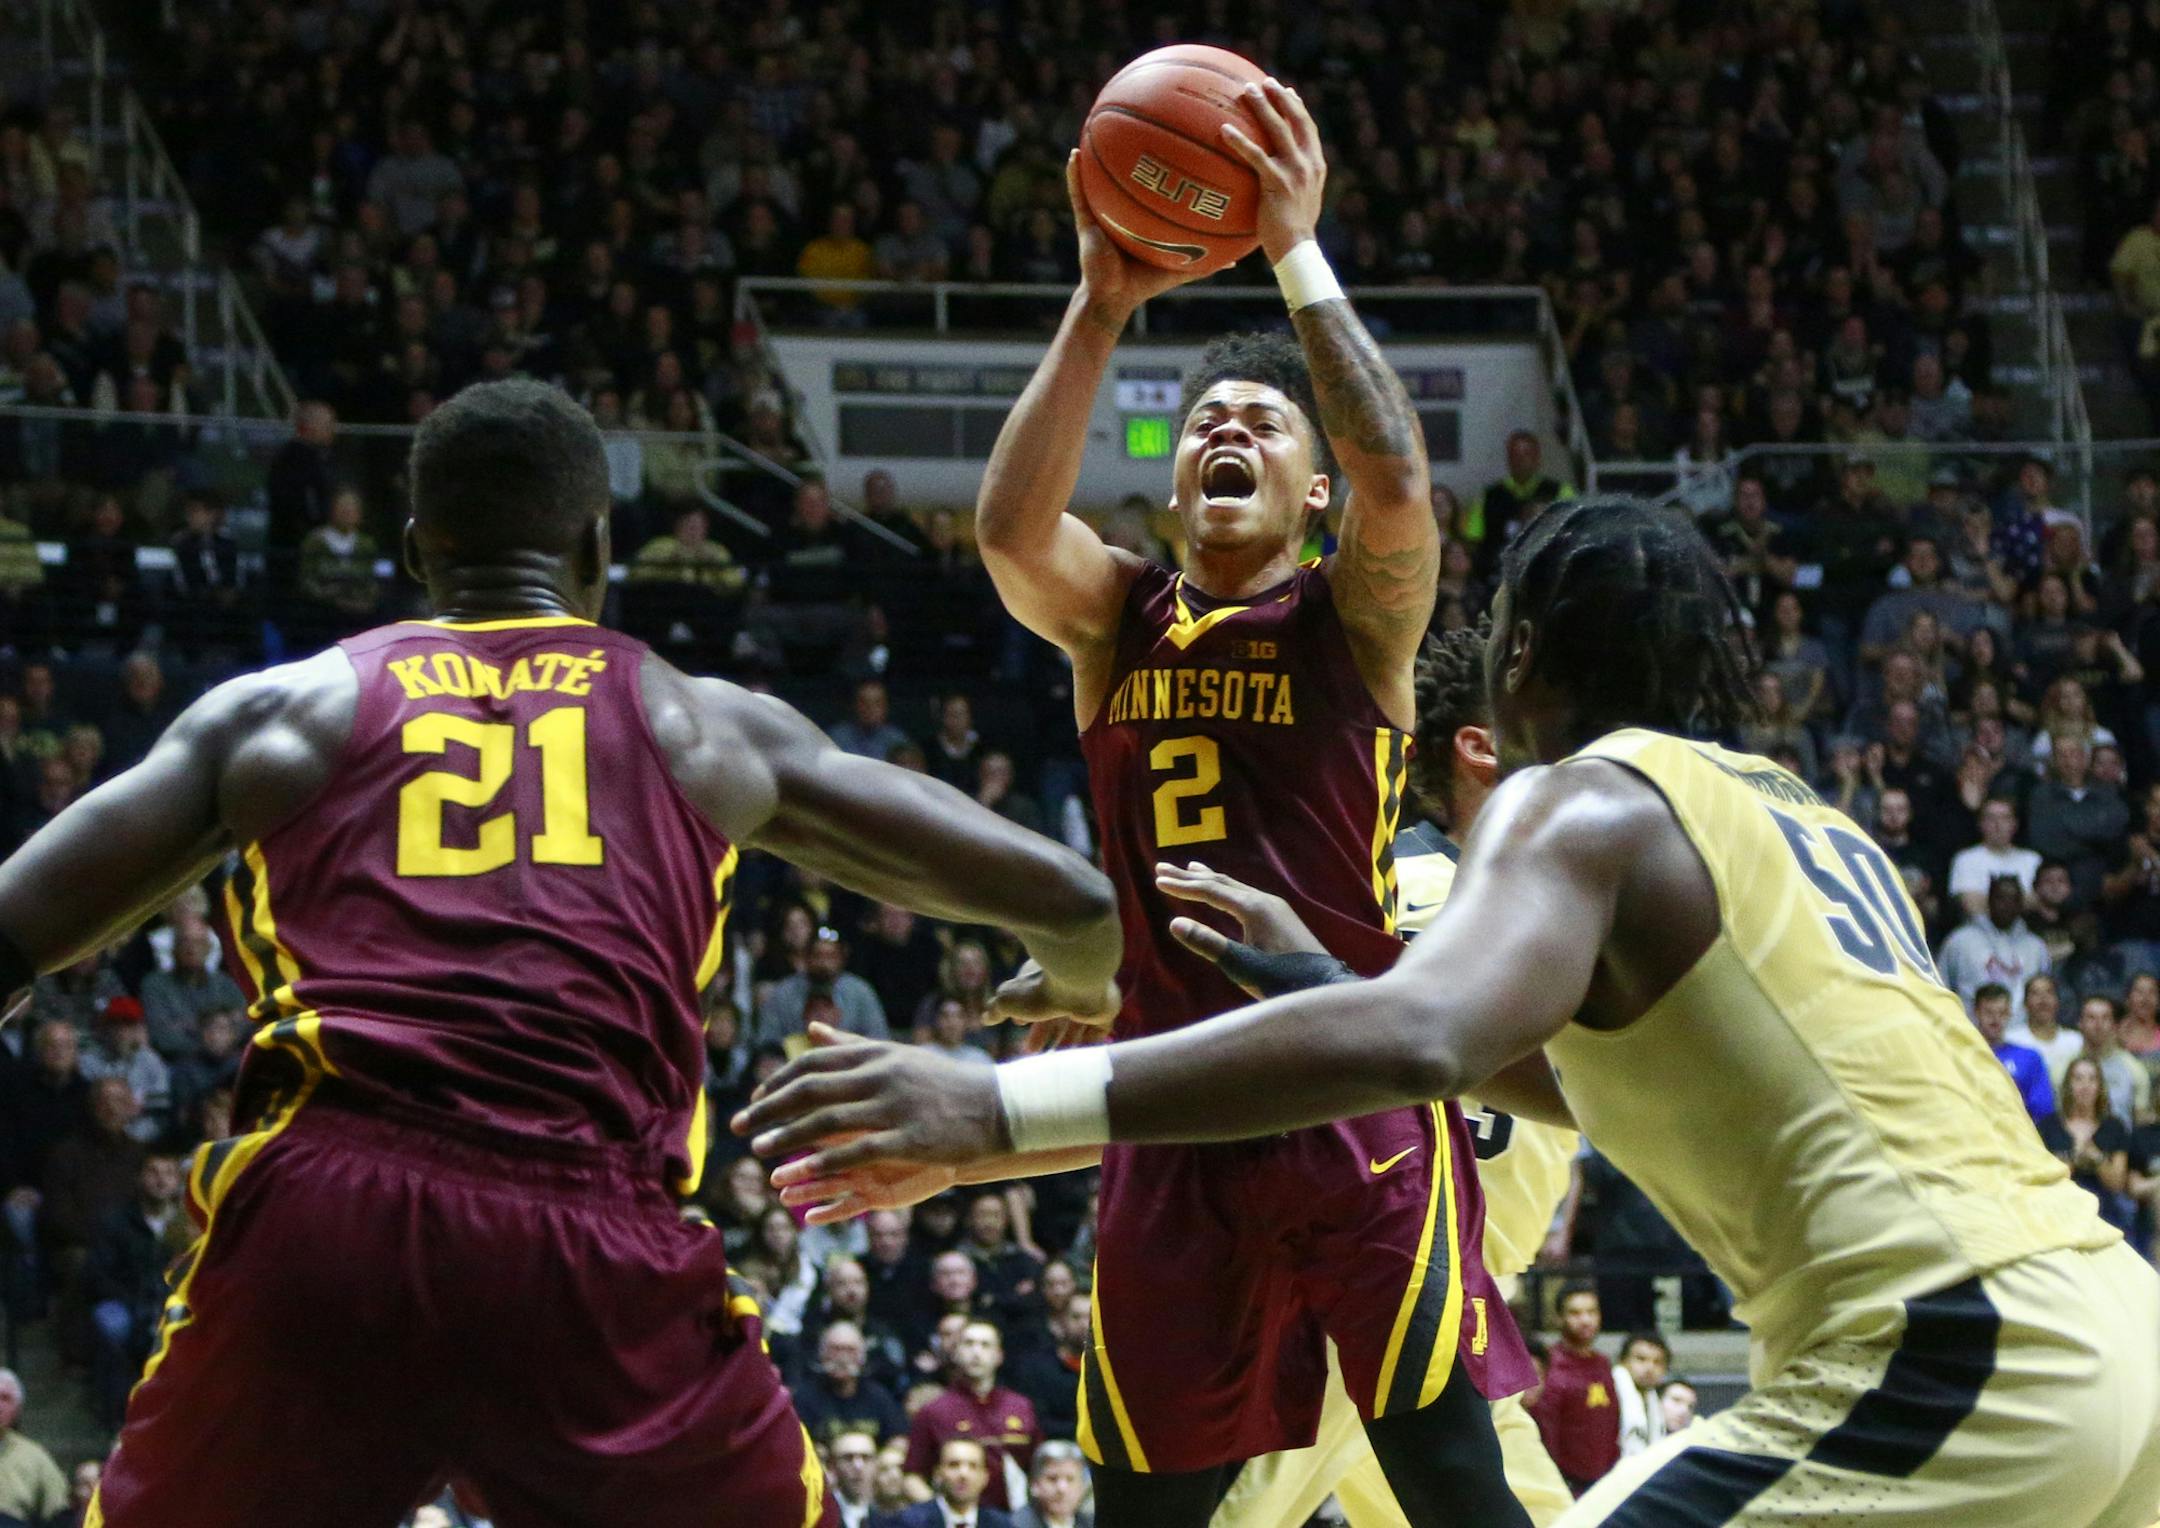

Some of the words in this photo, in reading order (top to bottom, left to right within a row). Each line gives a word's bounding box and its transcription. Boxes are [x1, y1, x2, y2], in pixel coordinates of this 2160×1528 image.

[1130, 154, 1231, 221] ELITE
[387, 649, 607, 700] KONATÉ
[1109, 668, 1294, 725] MINNESOTA
[397, 706, 603, 866] 21
[1150, 735, 1227, 848] 2
[1762, 803, 1944, 986] 50
